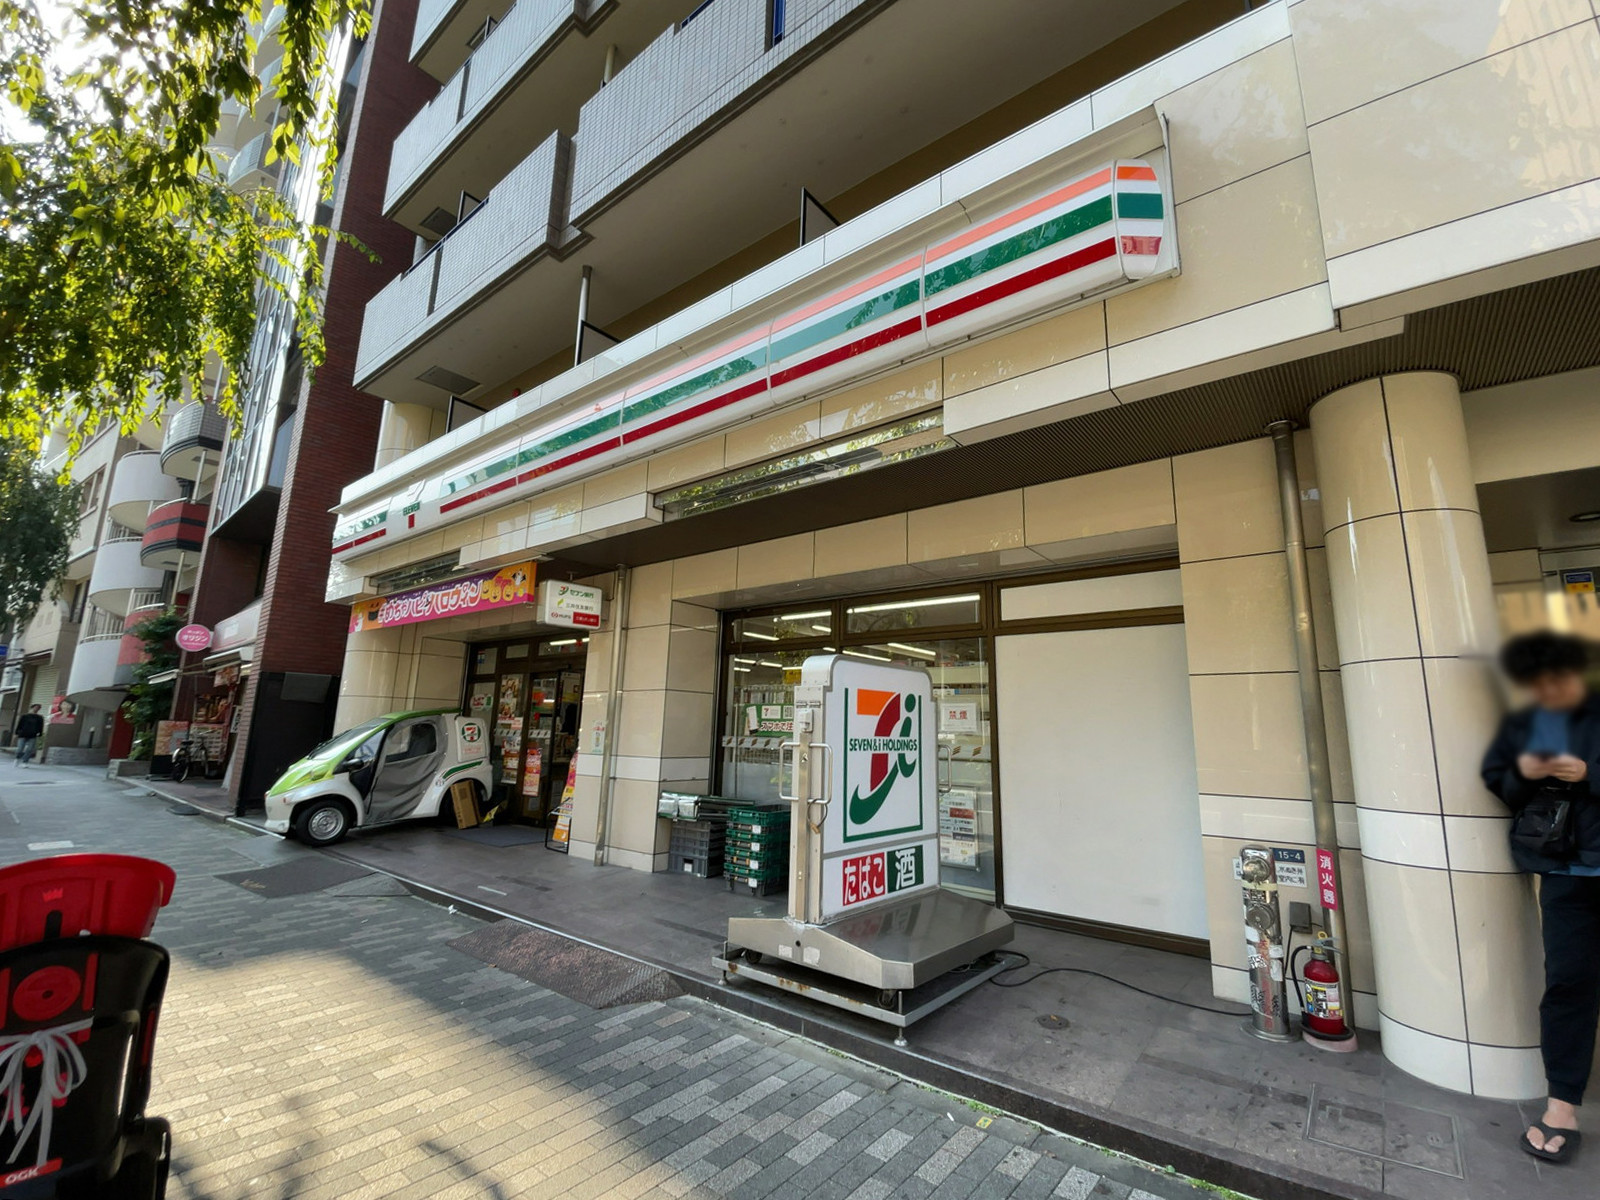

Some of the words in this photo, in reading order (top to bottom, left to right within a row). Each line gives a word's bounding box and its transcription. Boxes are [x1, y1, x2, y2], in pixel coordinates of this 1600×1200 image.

[882, 739, 918, 751] HOLDINGS
[895, 848, 916, 890] 酒
[1278, 850, 1301, 860] 15-4
[844, 856, 884, 904] たばこ
[1319, 855, 1335, 905] 消火器
[5, 1166, 40, 1184] OGK
